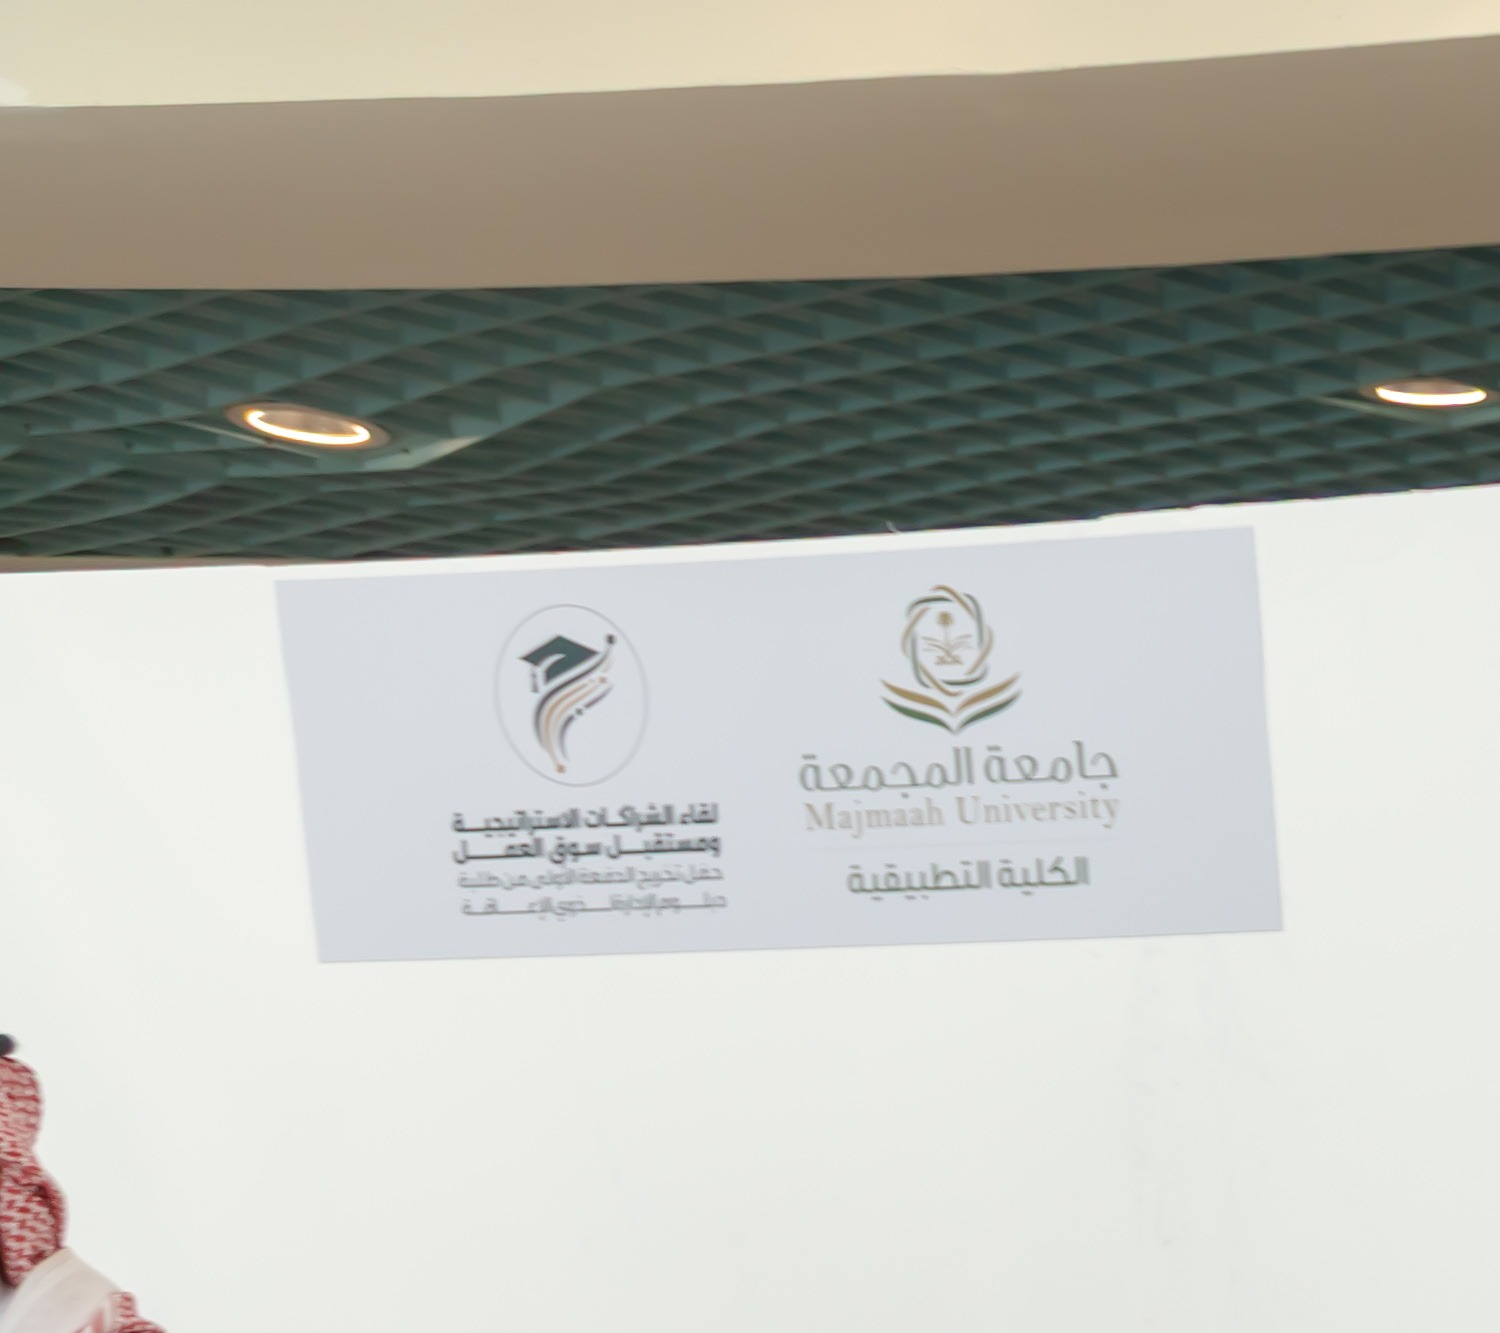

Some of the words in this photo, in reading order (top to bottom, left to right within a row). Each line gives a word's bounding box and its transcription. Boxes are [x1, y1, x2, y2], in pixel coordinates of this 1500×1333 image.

[800, 747, 975, 798] المجمعة
[984, 740, 1119, 789] جامعة
[803, 798, 945, 838] Majmaah
[955, 791, 1119, 828] University
[847, 860, 992, 901] التطبيقية
[998, 856, 1090, 897] الكلية
